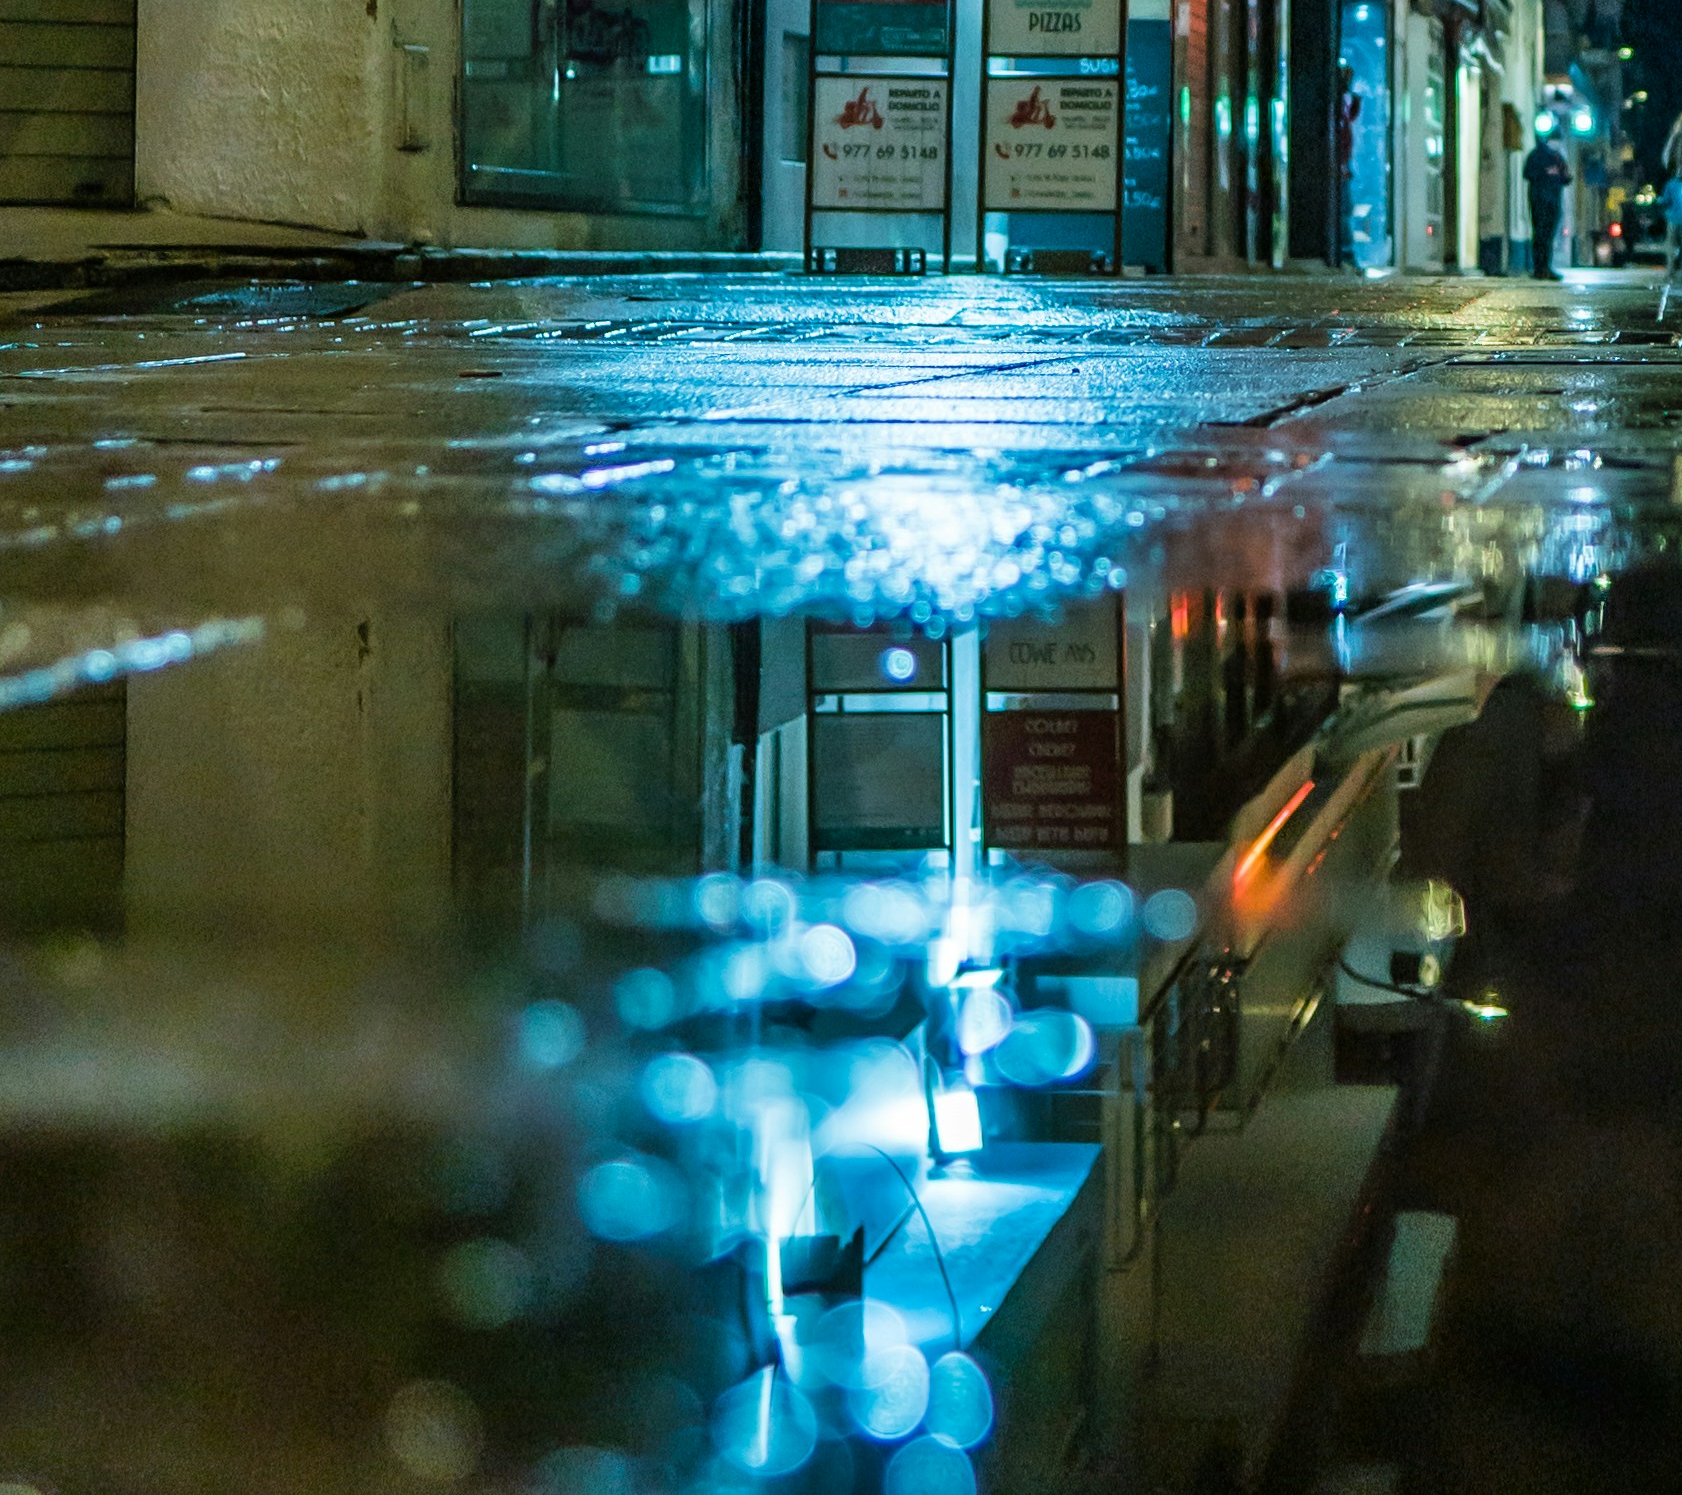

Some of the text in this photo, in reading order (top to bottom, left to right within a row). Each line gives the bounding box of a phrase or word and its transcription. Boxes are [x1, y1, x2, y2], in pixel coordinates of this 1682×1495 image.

[1028, 11, 1082, 32] PIZZAS
[842, 144, 938, 160] 977 69 5148
[1014, 143, 1043, 158] 977
[1047, 144, 1067, 159] 69
[1071, 145, 1111, 160] 5148
